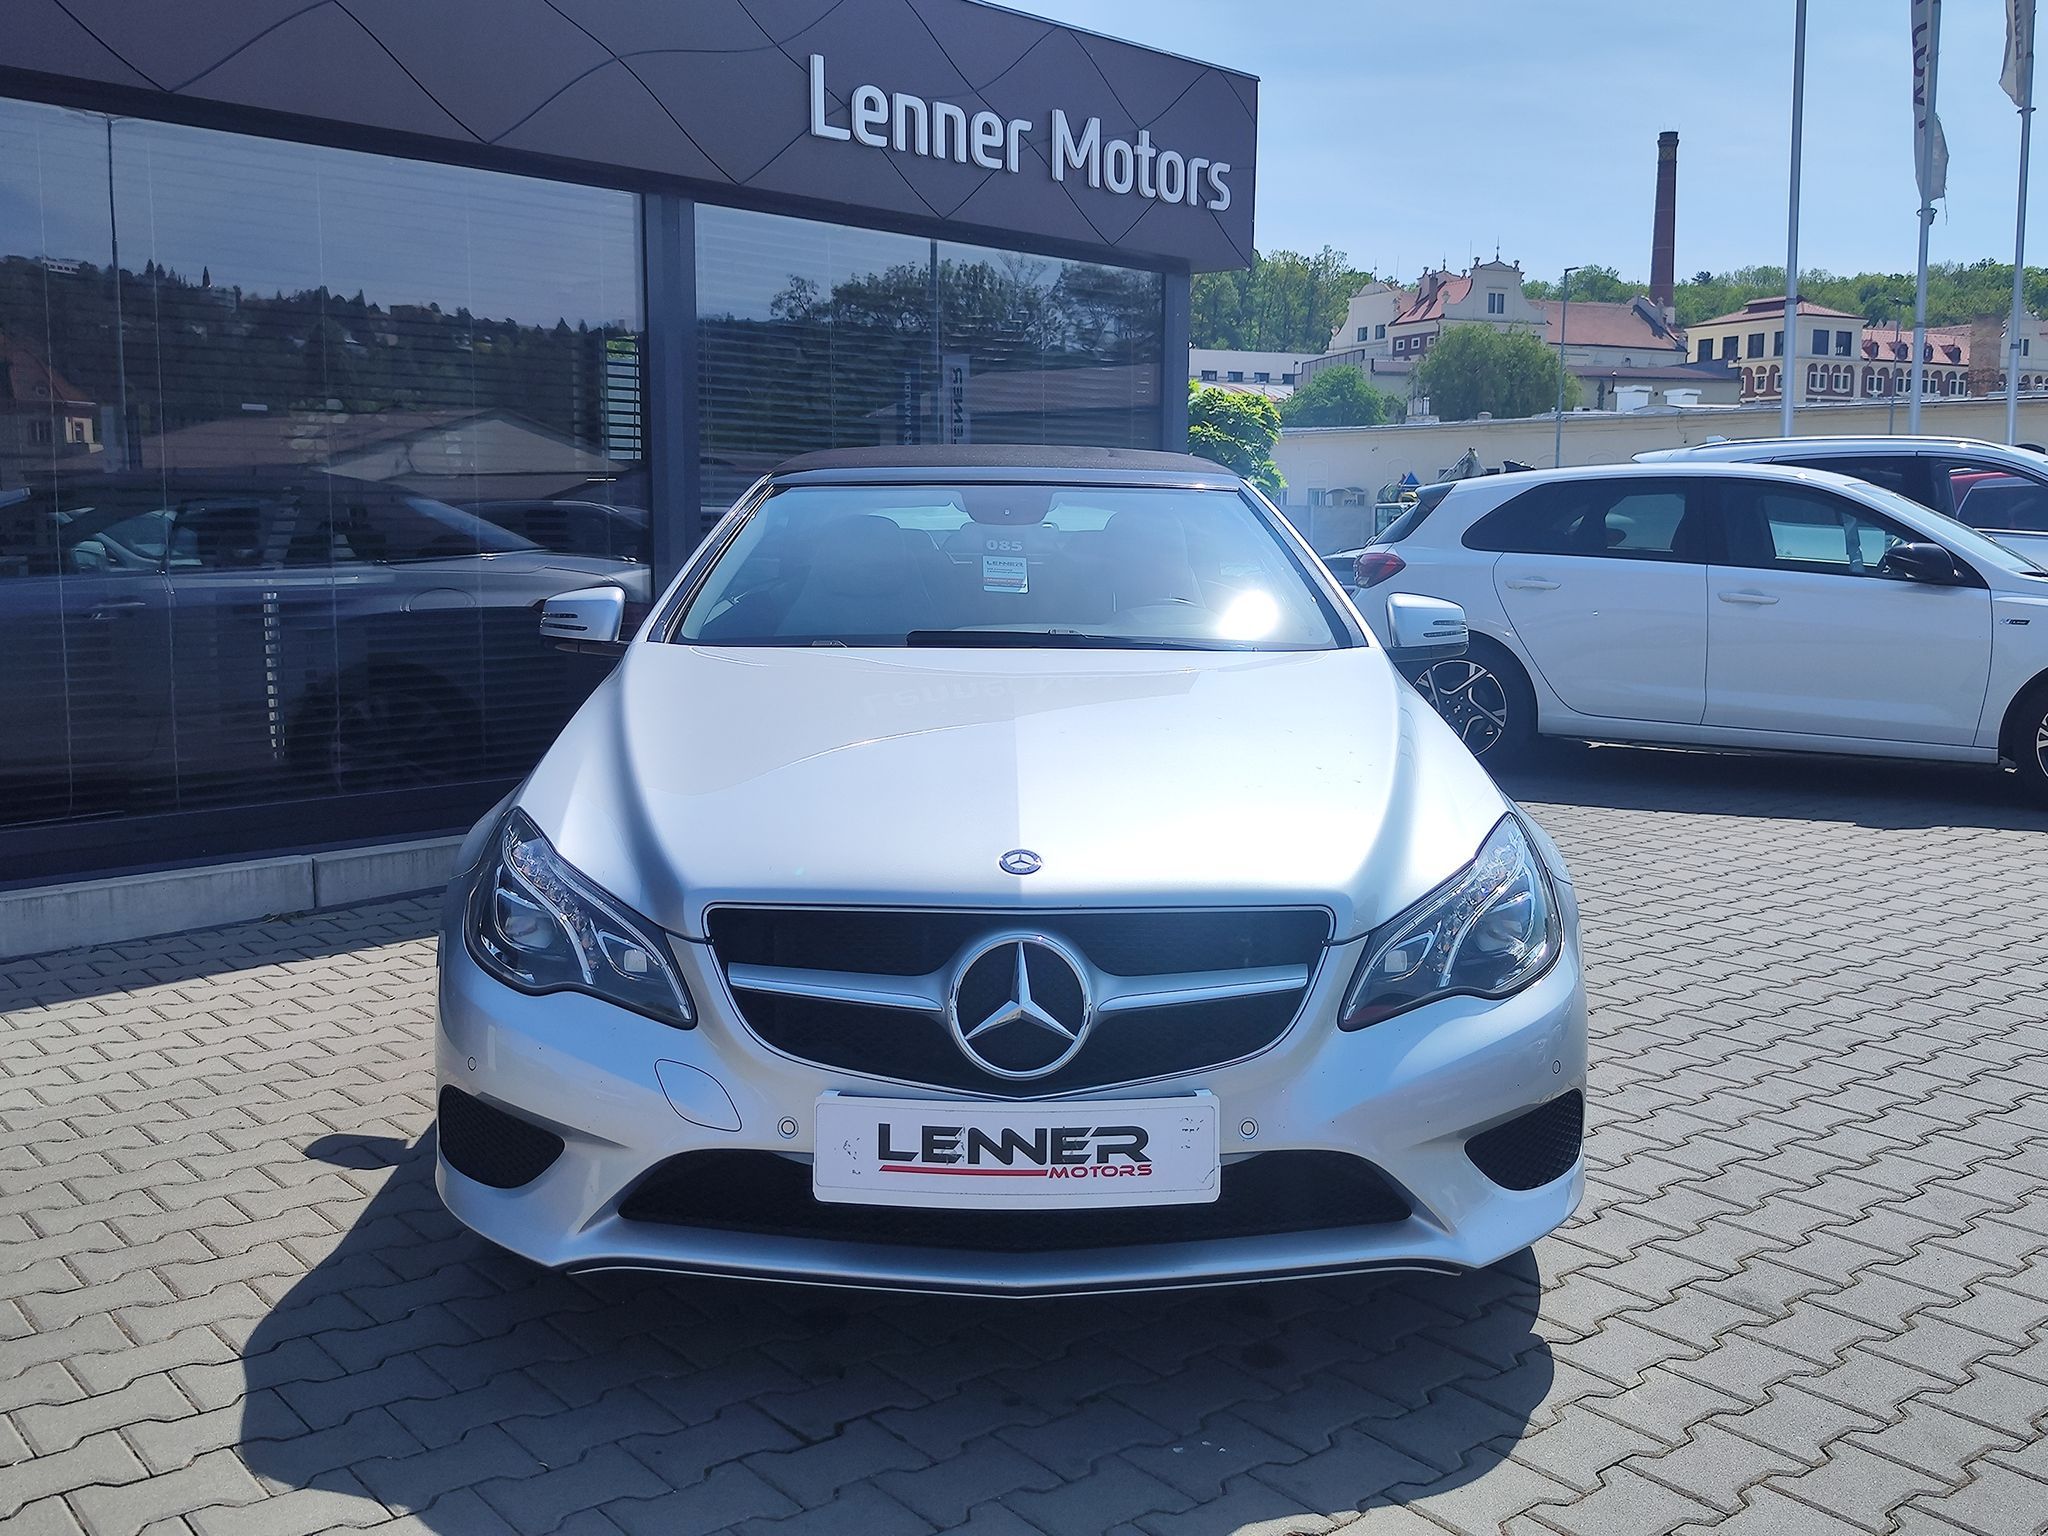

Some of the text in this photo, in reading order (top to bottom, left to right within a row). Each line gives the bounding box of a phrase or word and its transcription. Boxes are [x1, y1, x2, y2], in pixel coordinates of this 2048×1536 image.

[809, 53, 1232, 212] Lenner Motors
[986, 540, 1023, 551] 085
[878, 1122, 1151, 1166] LENNER
[1048, 1163, 1153, 1179] MOTORS
